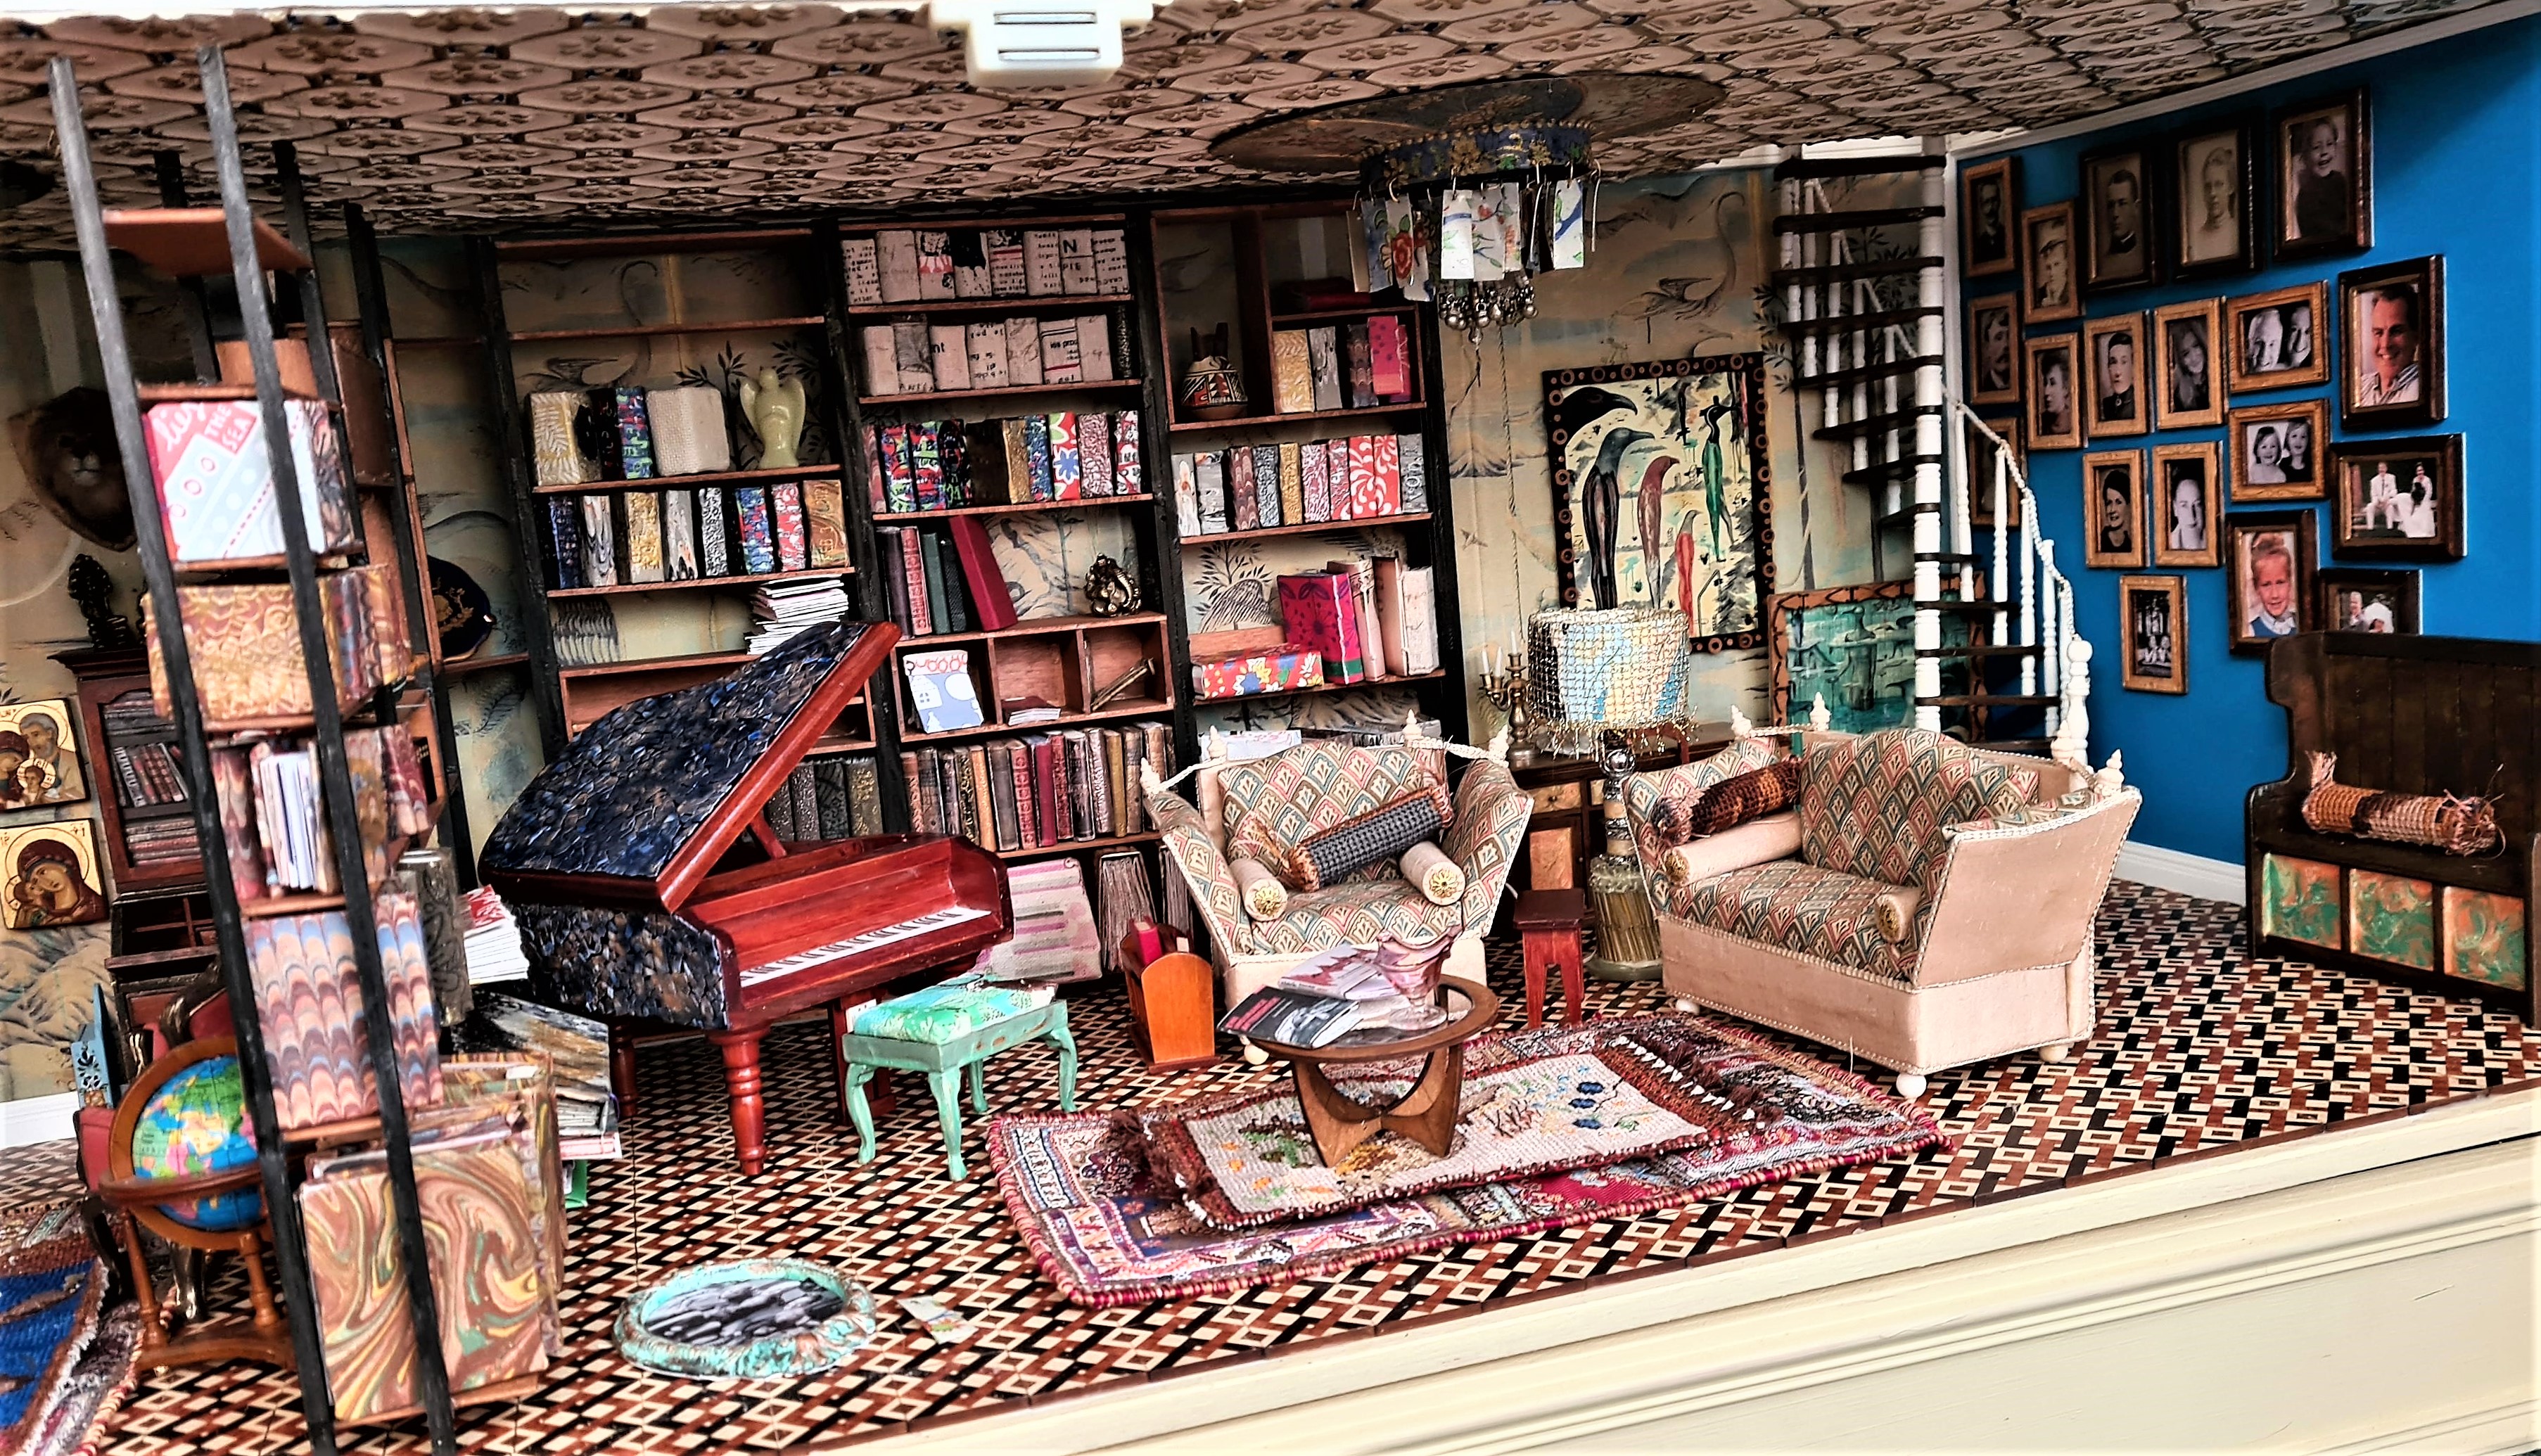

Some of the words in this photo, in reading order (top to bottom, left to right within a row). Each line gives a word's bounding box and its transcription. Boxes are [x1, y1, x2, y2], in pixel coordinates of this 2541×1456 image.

[1063, 239, 1077, 253] N
[204, 404, 232, 438] THE
[222, 417, 251, 452] SEA
